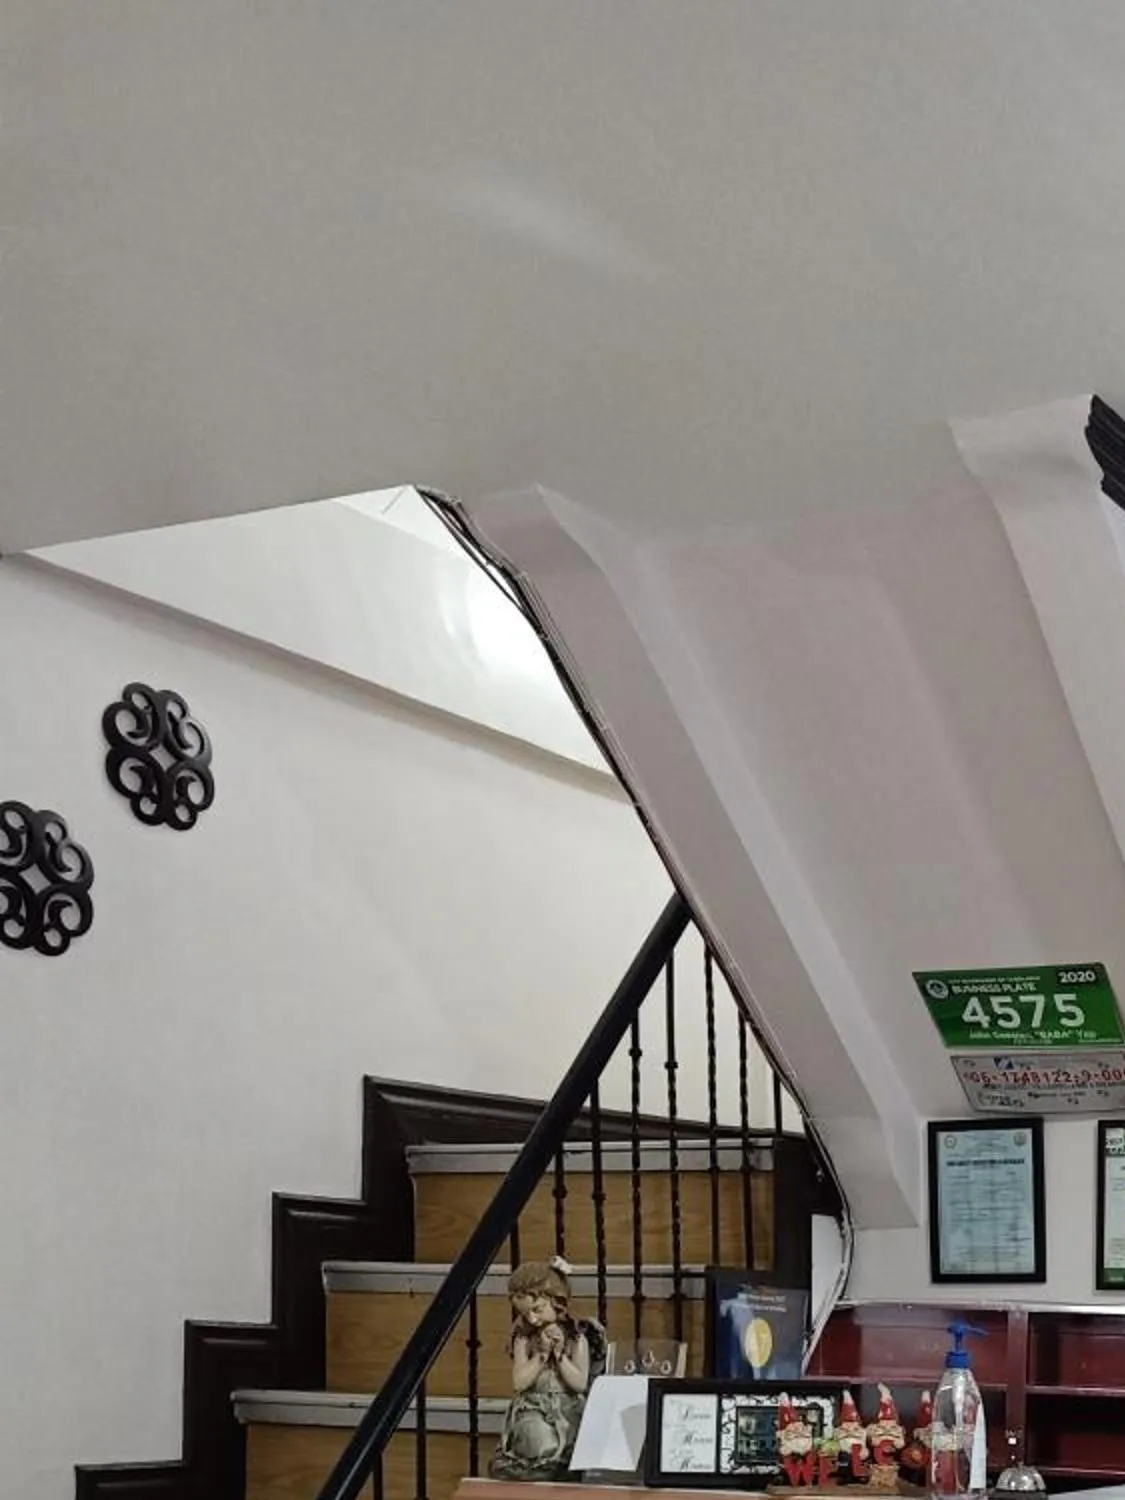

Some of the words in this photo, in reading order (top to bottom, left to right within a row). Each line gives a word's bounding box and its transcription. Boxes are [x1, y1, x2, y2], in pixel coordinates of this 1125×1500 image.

[1058, 970, 1096, 983] 2020
[1002, 981, 1037, 992] PLATE
[961, 993, 1085, 1029] 4575
